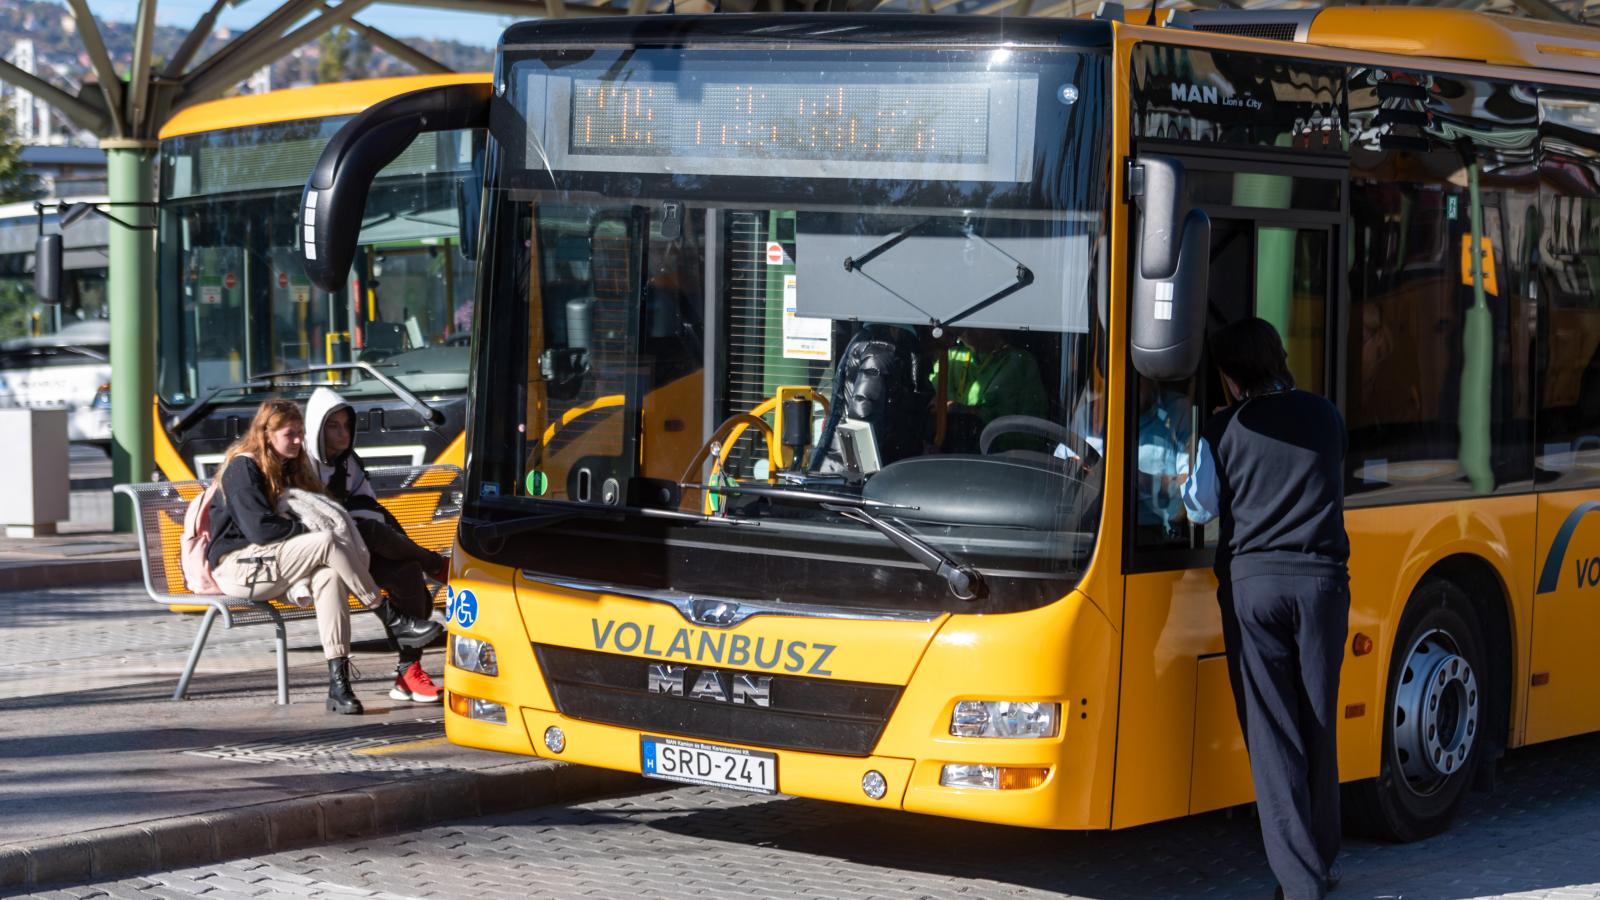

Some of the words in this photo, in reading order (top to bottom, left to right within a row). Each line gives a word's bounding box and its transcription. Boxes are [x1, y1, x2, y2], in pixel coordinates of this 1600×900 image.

[1171, 82, 1218, 105] MAN
[1222, 96, 1244, 107] Lion's
[1246, 98, 1263, 110] City
[591, 618, 838, 676] VOLÁNBUSZ
[648, 664, 775, 708] MAN
[647, 759, 654, 769] H
[662, 747, 766, 785] SRD-241
